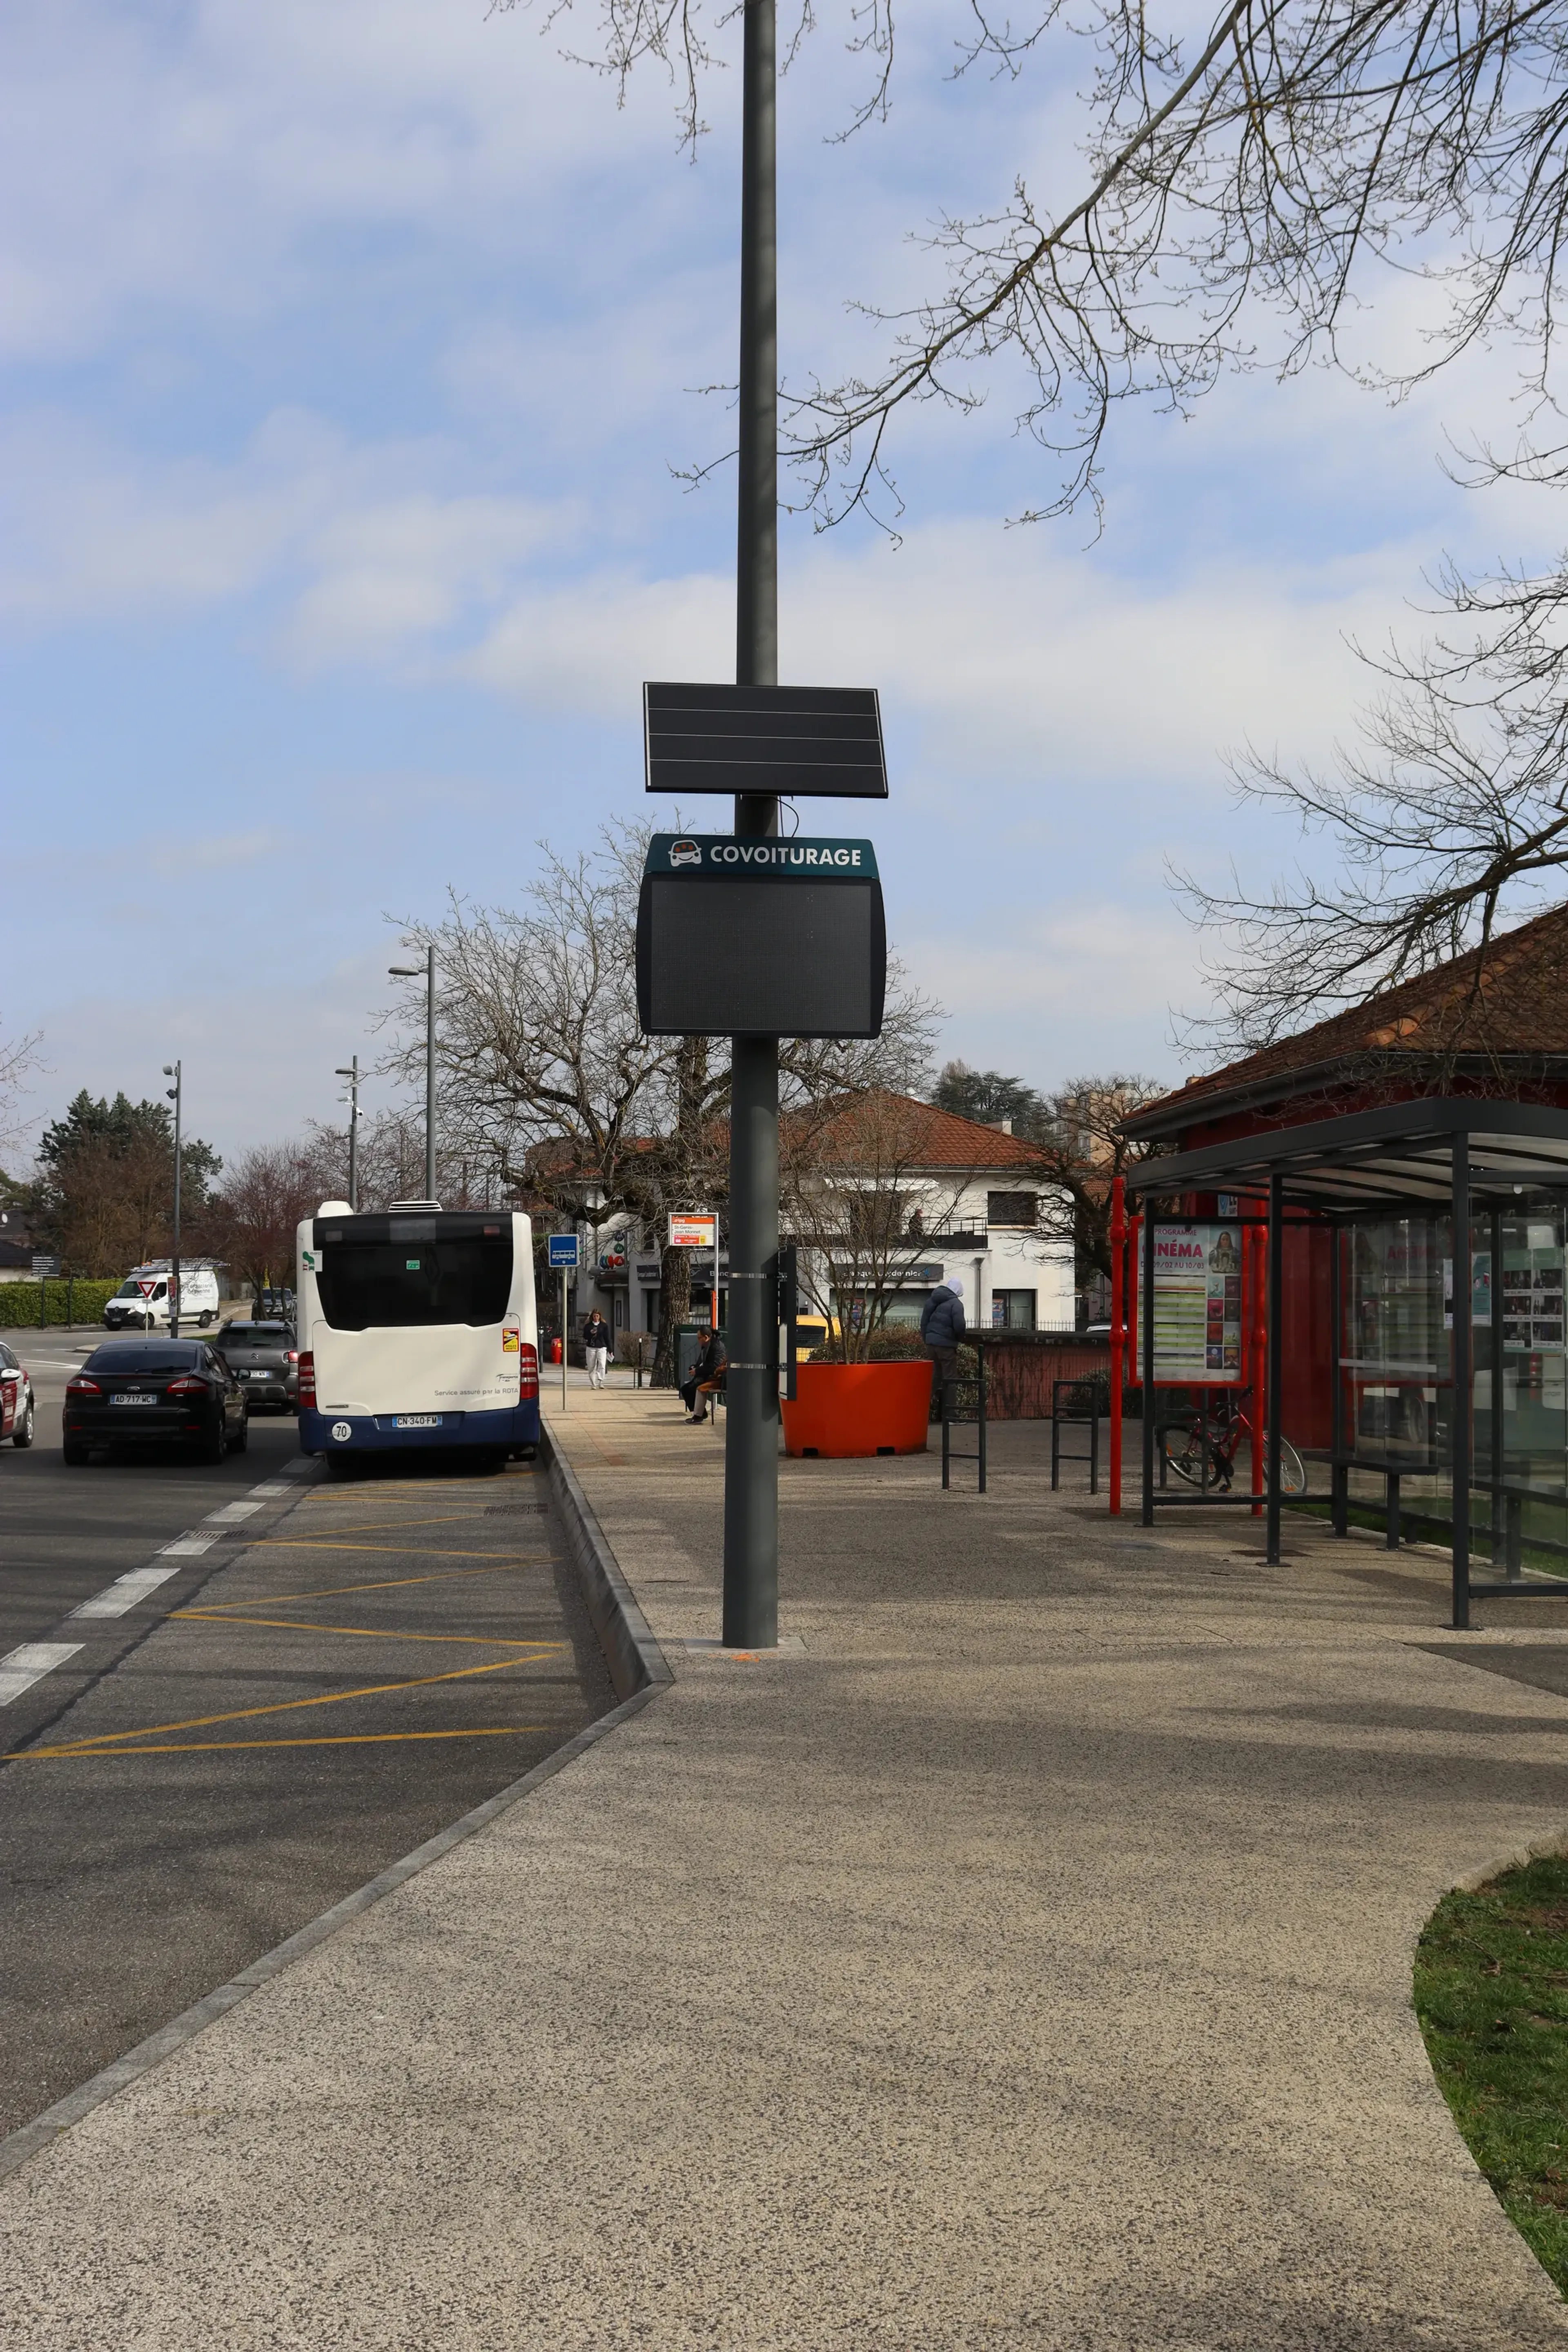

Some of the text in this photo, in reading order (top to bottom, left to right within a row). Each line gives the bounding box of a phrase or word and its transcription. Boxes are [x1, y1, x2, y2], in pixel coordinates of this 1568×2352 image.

[710, 846, 861, 866] COVOITURAGE
[1142, 1238, 1203, 1258] INÉMA
[337, 1425, 347, 1438] 70
